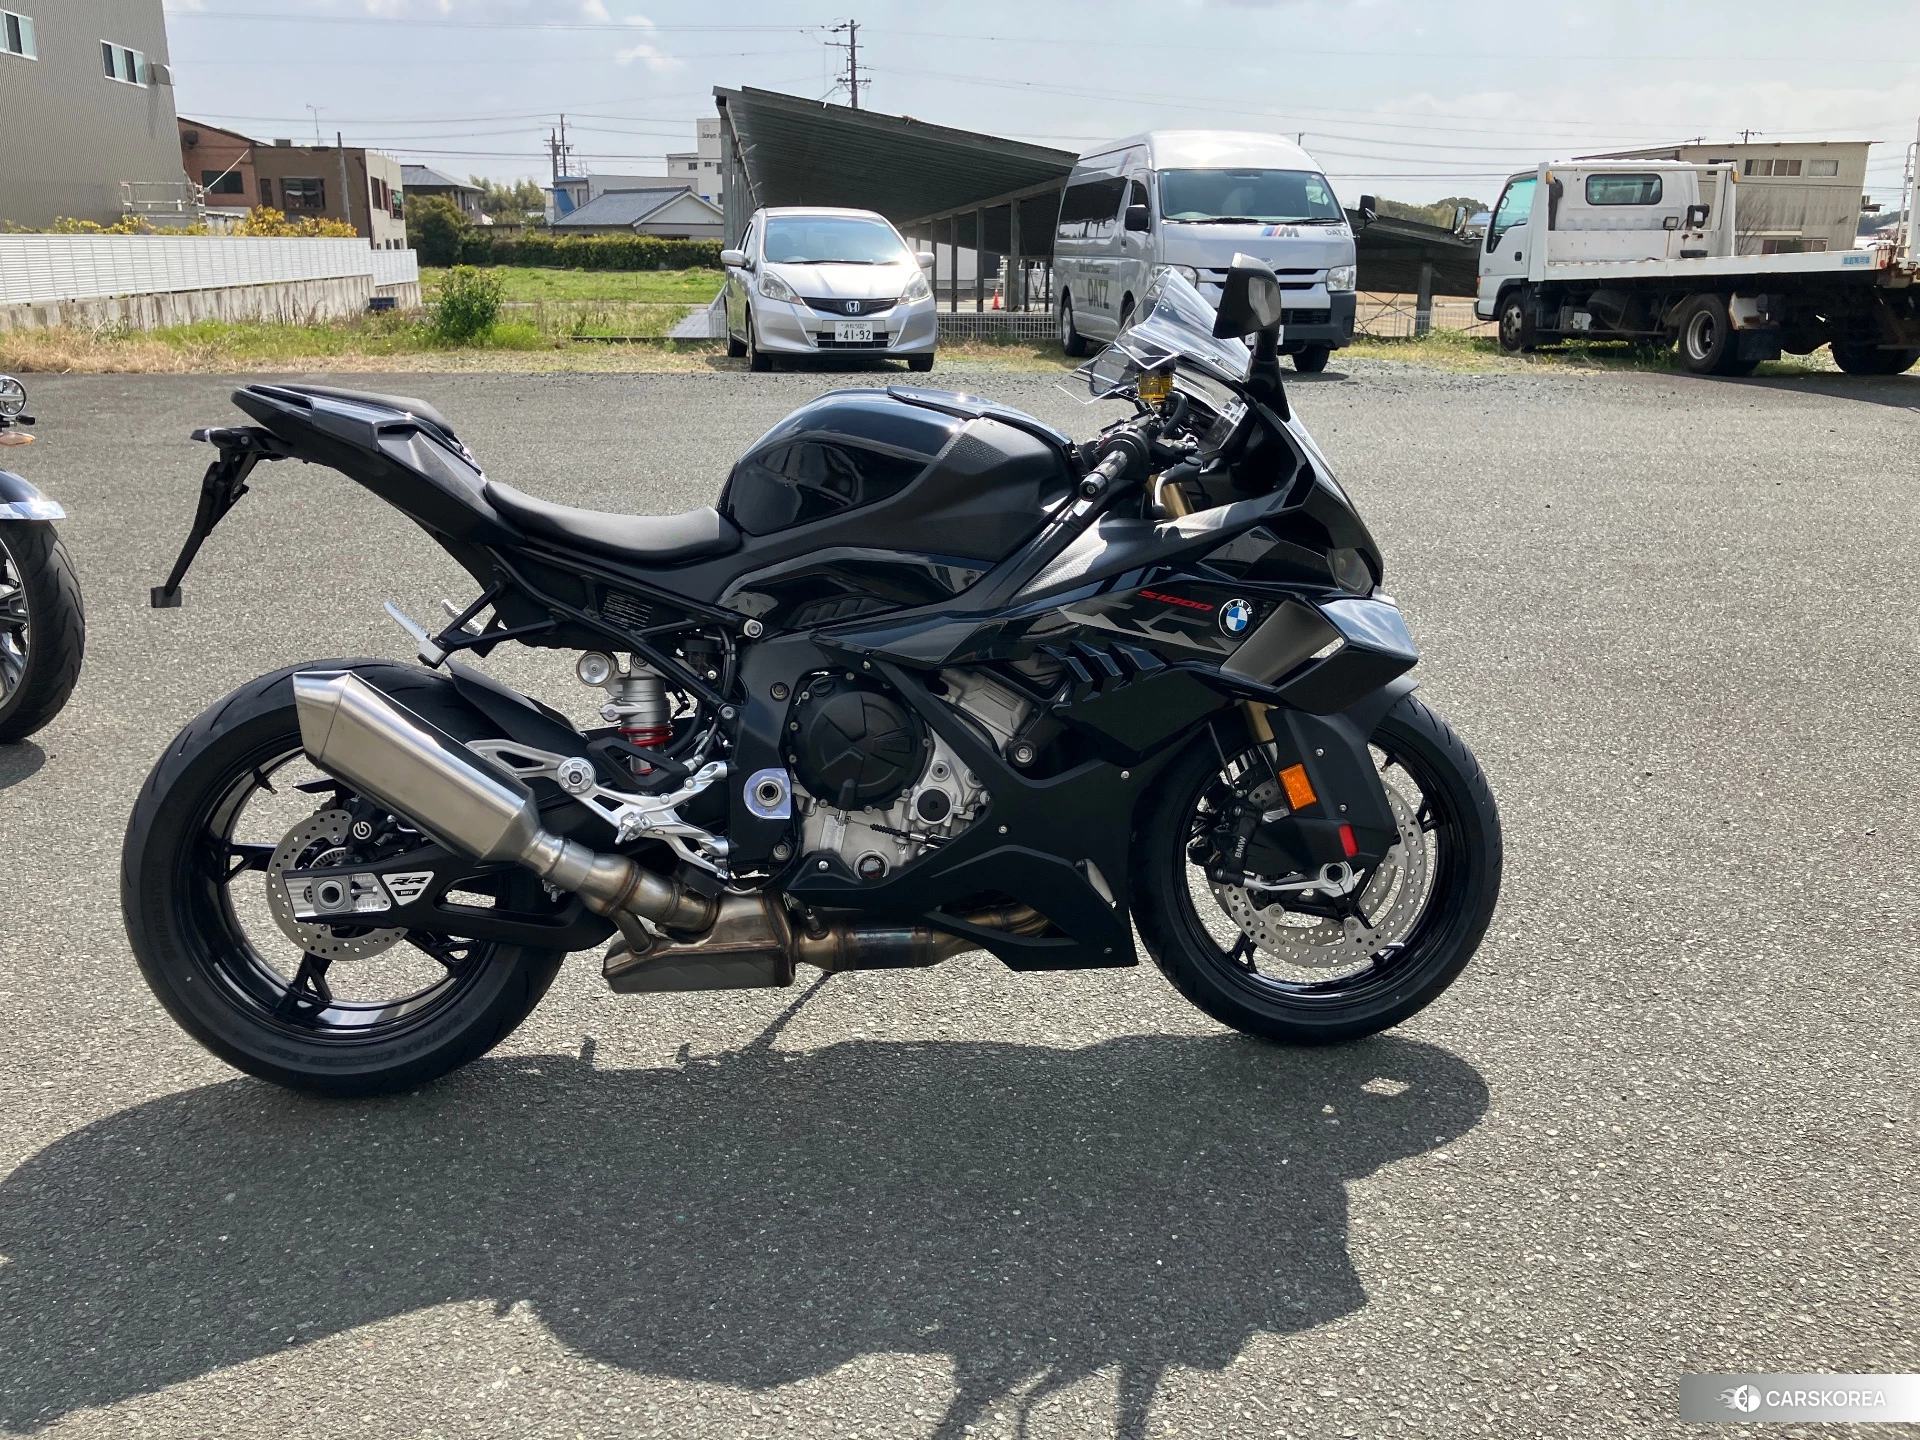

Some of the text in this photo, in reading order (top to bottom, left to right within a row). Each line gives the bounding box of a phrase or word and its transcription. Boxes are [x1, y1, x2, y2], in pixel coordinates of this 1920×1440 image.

[1325, 228, 1349, 237] DATZ
[1088, 278, 1110, 310] DATZ
[843, 330, 871, 340] 41-92
[1137, 590, 1214, 611] S1000
[1234, 835, 1246, 859] BMW
[388, 876, 430, 886] RR
